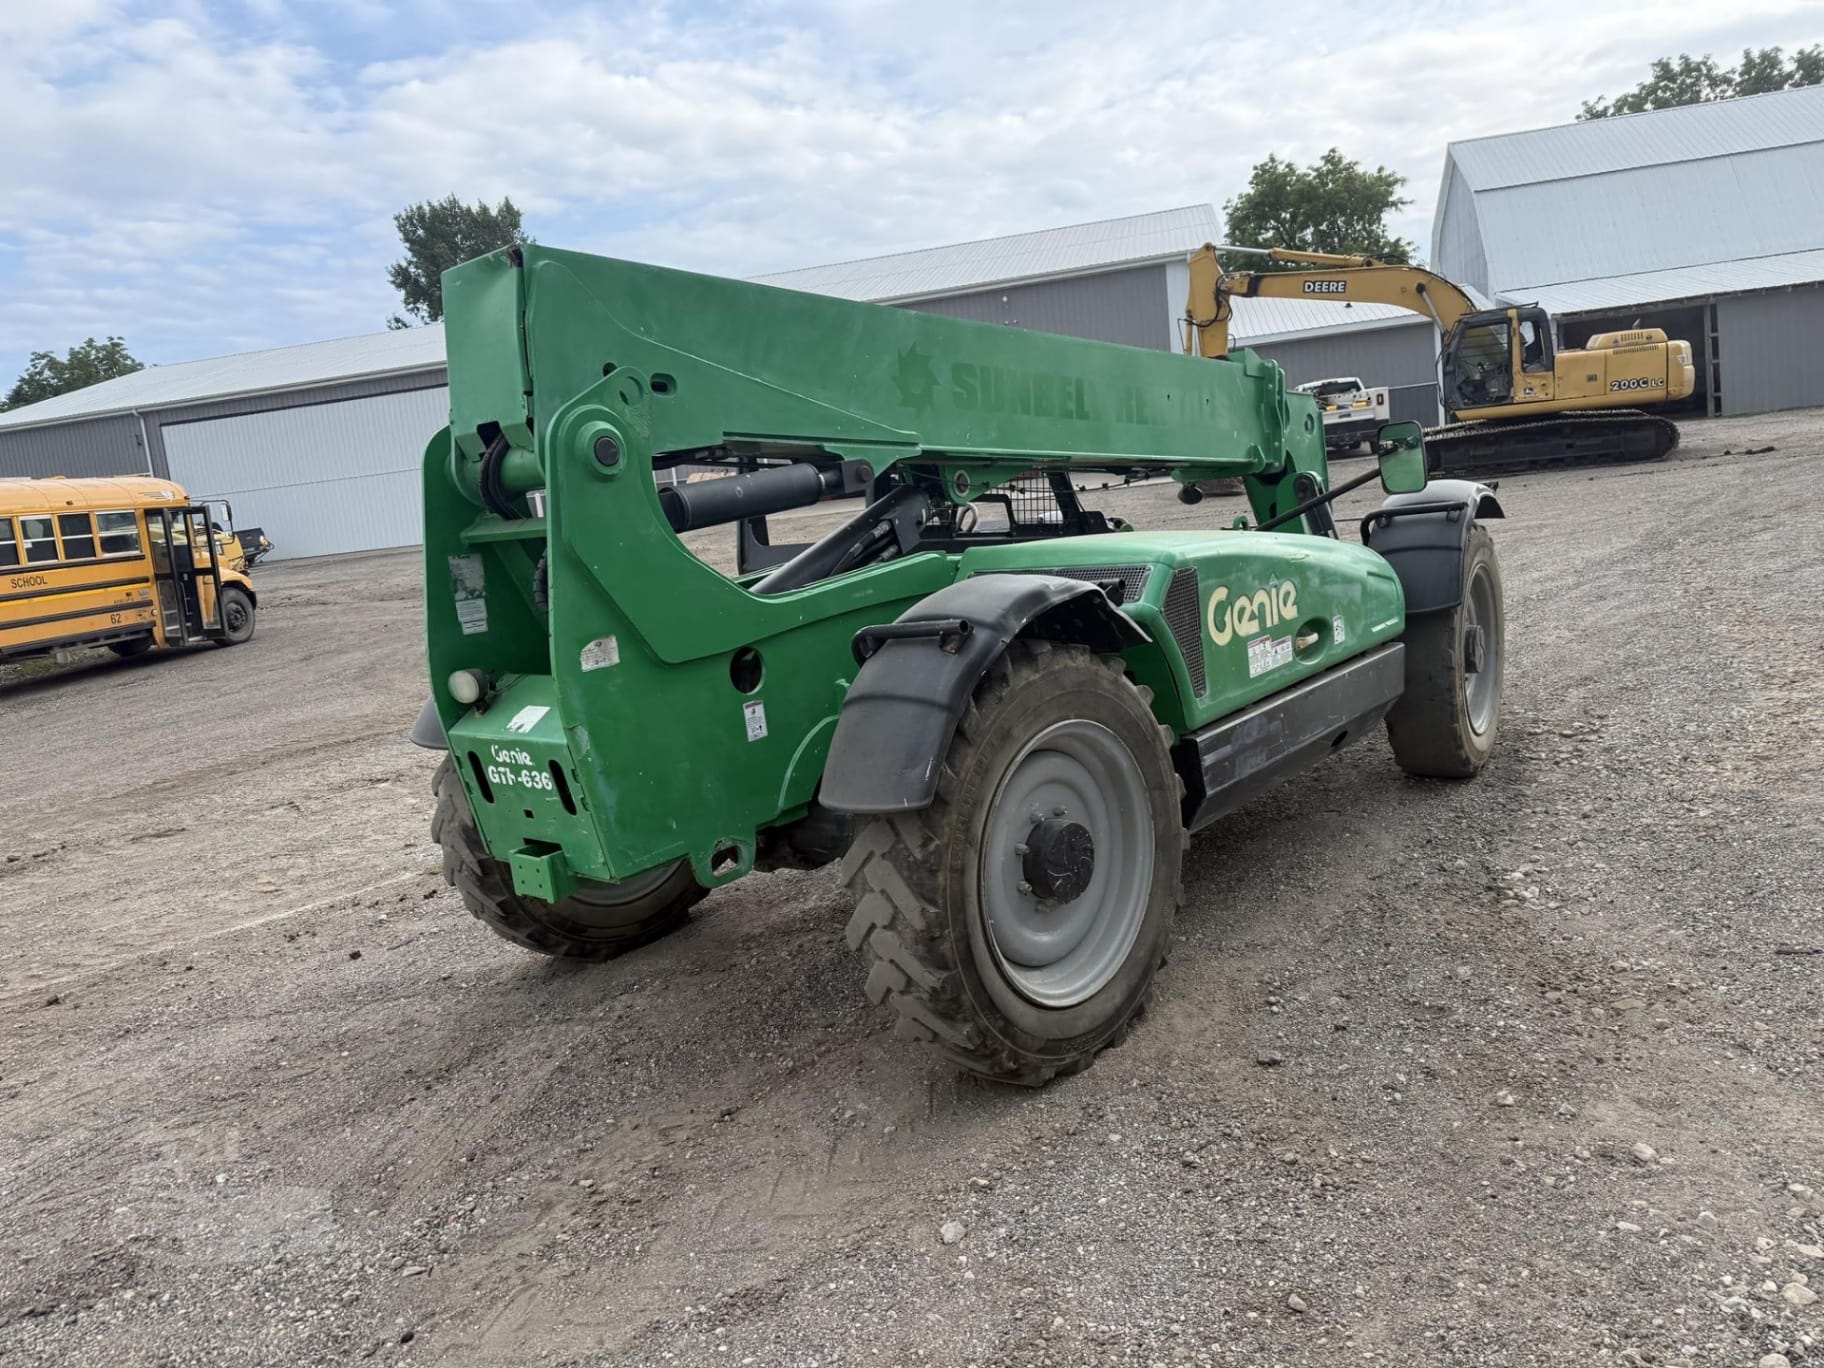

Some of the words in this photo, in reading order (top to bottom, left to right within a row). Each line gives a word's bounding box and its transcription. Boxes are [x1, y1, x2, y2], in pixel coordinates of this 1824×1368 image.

[1303, 280, 1347, 293] DEERE
[1610, 377, 1649, 391] 200C
[11, 575, 48, 589] SCHOOL
[110, 613, 122, 625] 62
[1207, 579, 1298, 647] Genie
[491, 744, 535, 766] Genie
